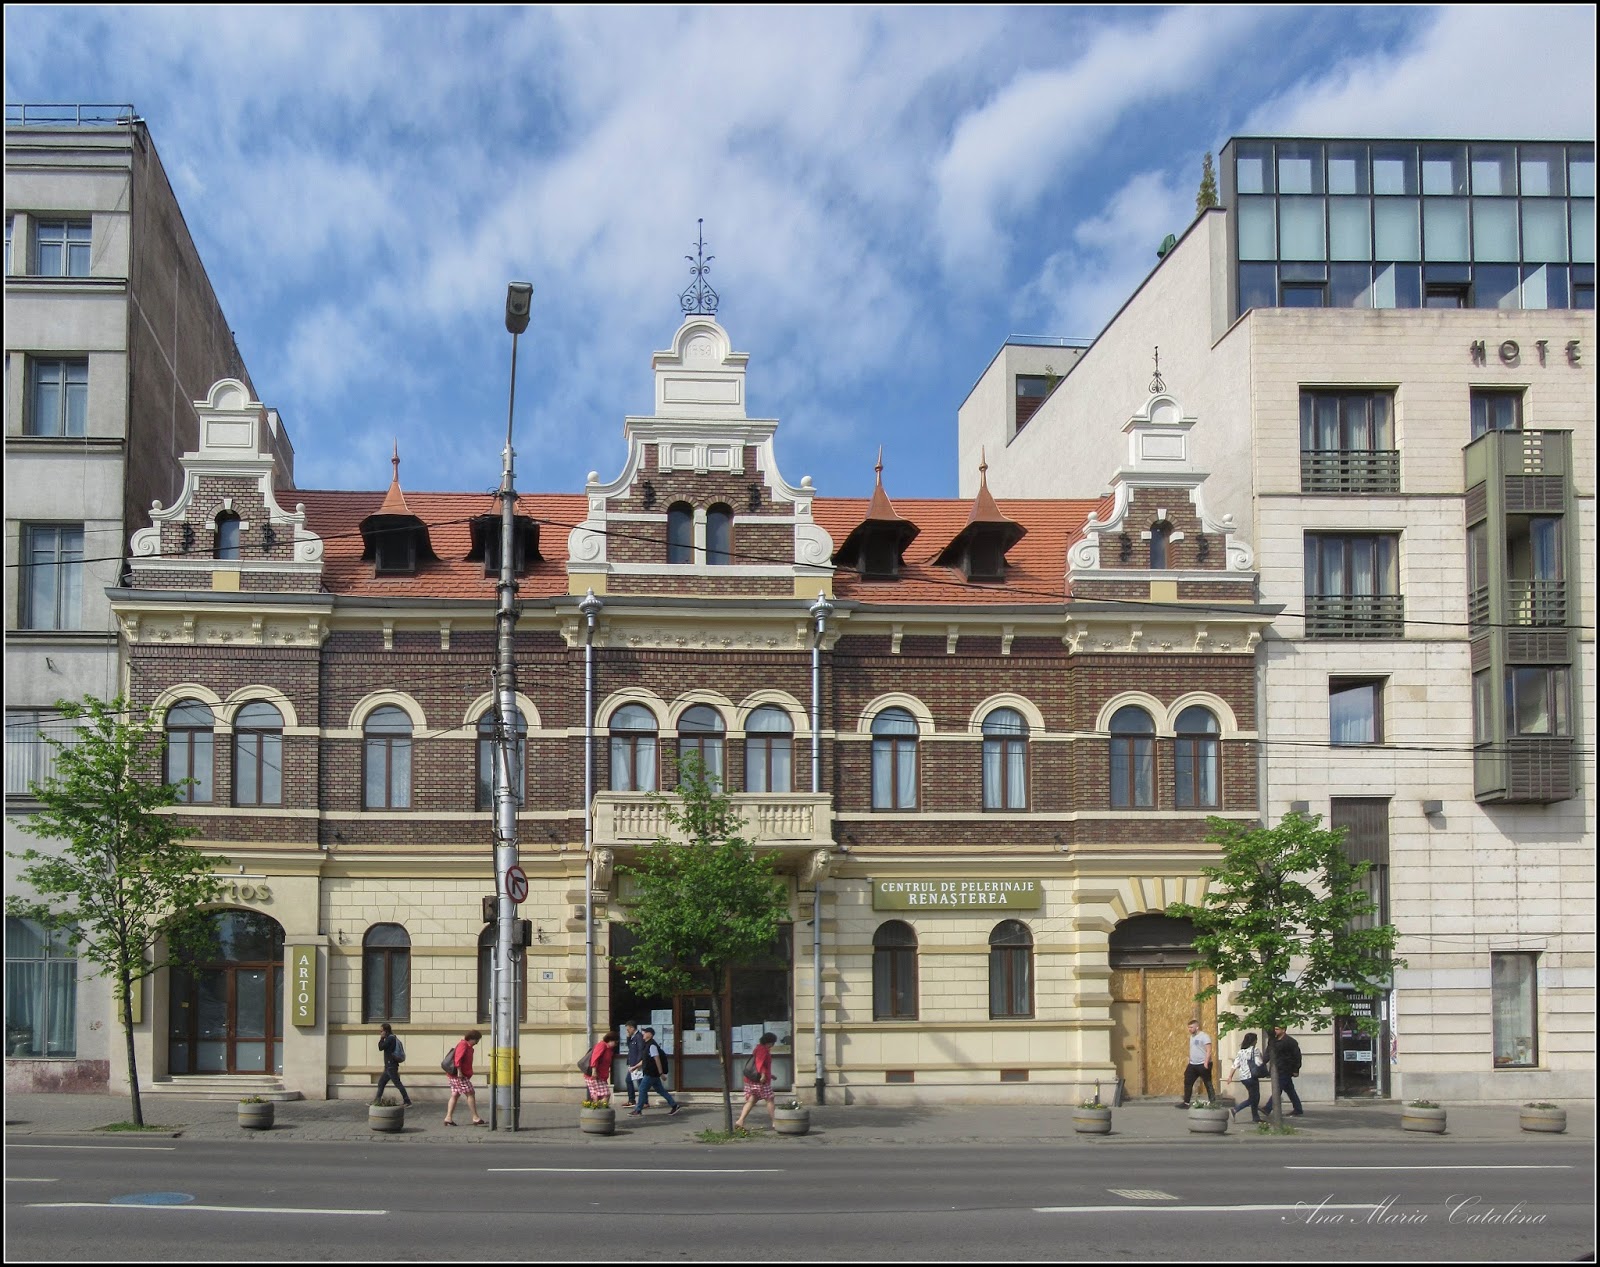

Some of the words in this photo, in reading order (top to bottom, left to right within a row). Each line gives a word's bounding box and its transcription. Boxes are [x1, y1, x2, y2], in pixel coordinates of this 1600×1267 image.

[1470, 340, 1581, 362] HOTE
[198, 880, 271, 900] rtos
[881, 882, 936, 892] CENTRUL
[941, 882, 956, 892] DE
[961, 881, 1034, 892] PELERINAJE
[298, 954, 309, 1017] ARTOS
